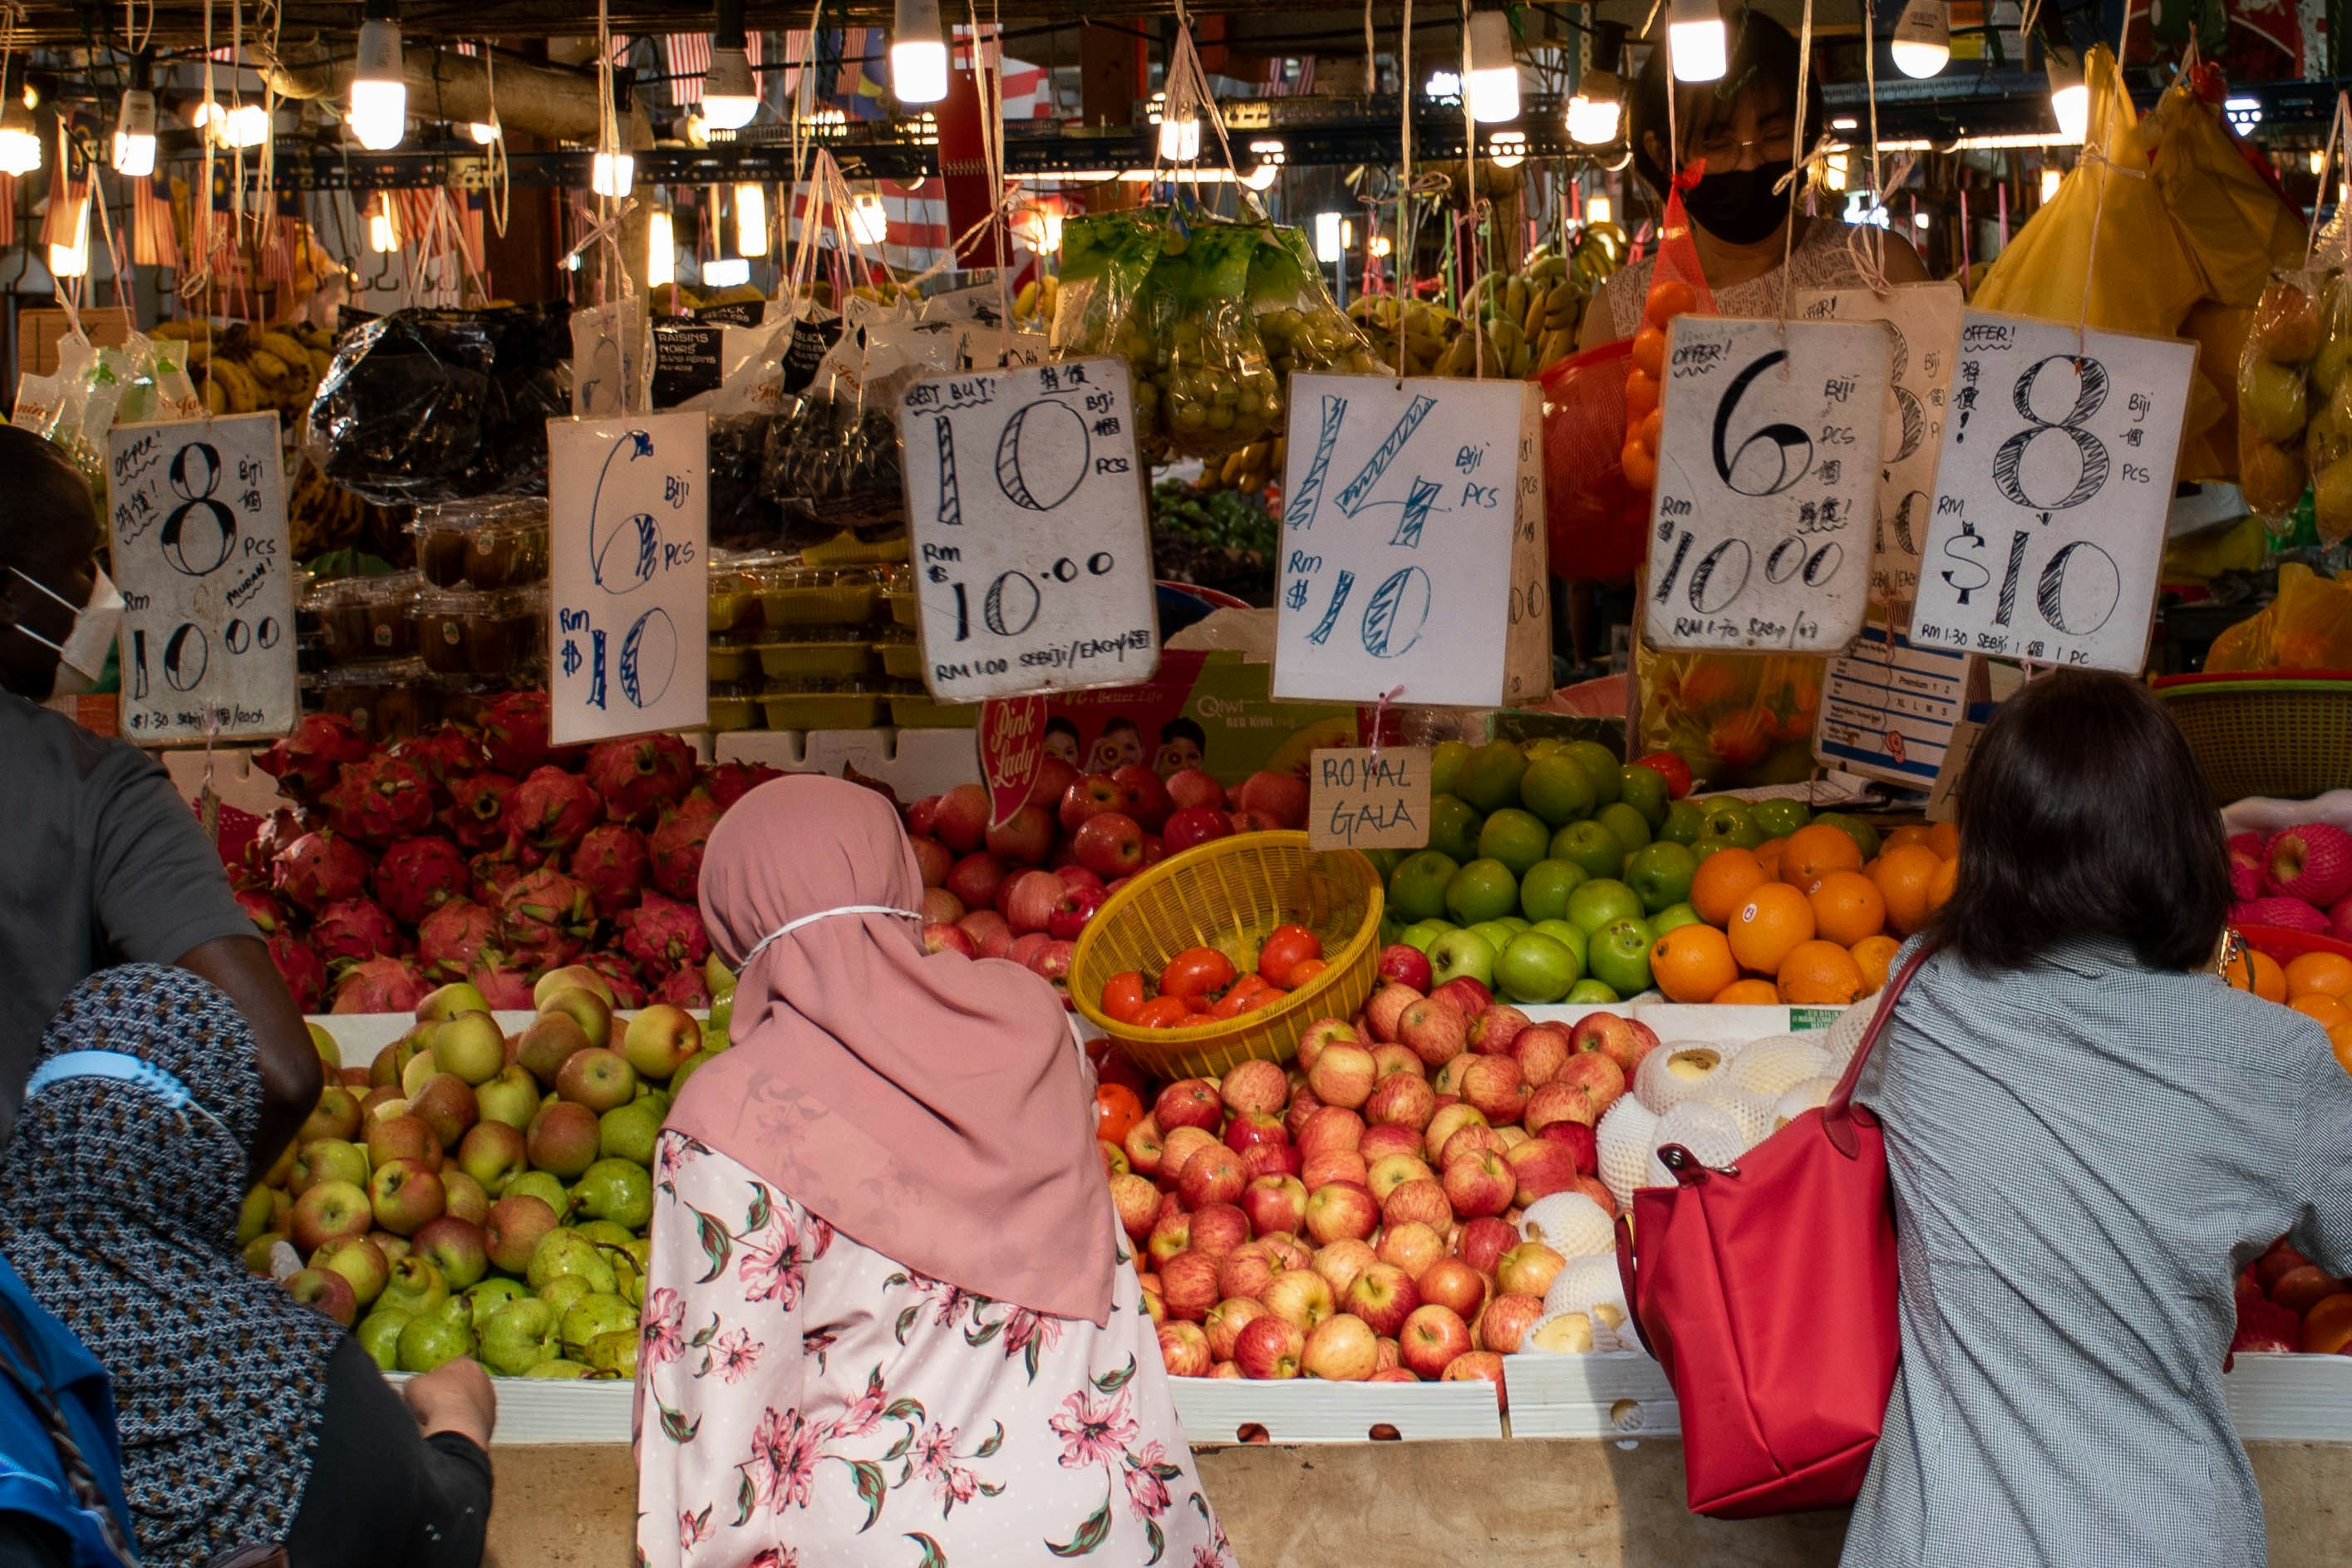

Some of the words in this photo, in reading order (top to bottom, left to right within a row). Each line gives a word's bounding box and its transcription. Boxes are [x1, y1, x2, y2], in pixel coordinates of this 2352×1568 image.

[657, 333, 709, 343] RAISINS
[1962, 325, 2015, 343] OFFER!
[1671, 339, 1732, 366] OFFER!
[905, 384, 940, 406] BEST
[951, 376, 996, 402] BUY!
[1085, 386, 1114, 415] Biji
[1823, 375, 1861, 403] Biji
[2128, 392, 2154, 422] Biji
[1712, 349, 1814, 496] 6
[1817, 425, 1856, 445] PCS
[1993, 354, 2110, 510] 8
[239, 455, 263, 487] Biji
[934, 400, 1090, 525] 10
[1095, 457, 1130, 475] PCS
[1285, 393, 1453, 549] 14
[1456, 442, 1491, 474] Biji
[2122, 464, 2151, 484] PCS
[664, 469, 691, 509] Biji
[1462, 482, 1499, 509] PCS
[160, 442, 238, 574] 8
[590, 430, 662, 595] 6
[1660, 496, 1692, 518] Rm
[1937, 495, 1965, 518] RM
[245, 538, 276, 558] PCS
[664, 543, 695, 572] PCS
[922, 543, 962, 563] Rm
[1287, 549, 1323, 574] Rm
[560, 607, 589, 634] Rm
[1197, 695, 1244, 718] Qiwi
[991, 696, 1036, 753] Pink
[992, 736, 1036, 788] Lady
[1323, 756, 1411, 793] ROYAL
[1331, 799, 1418, 846] GALA
